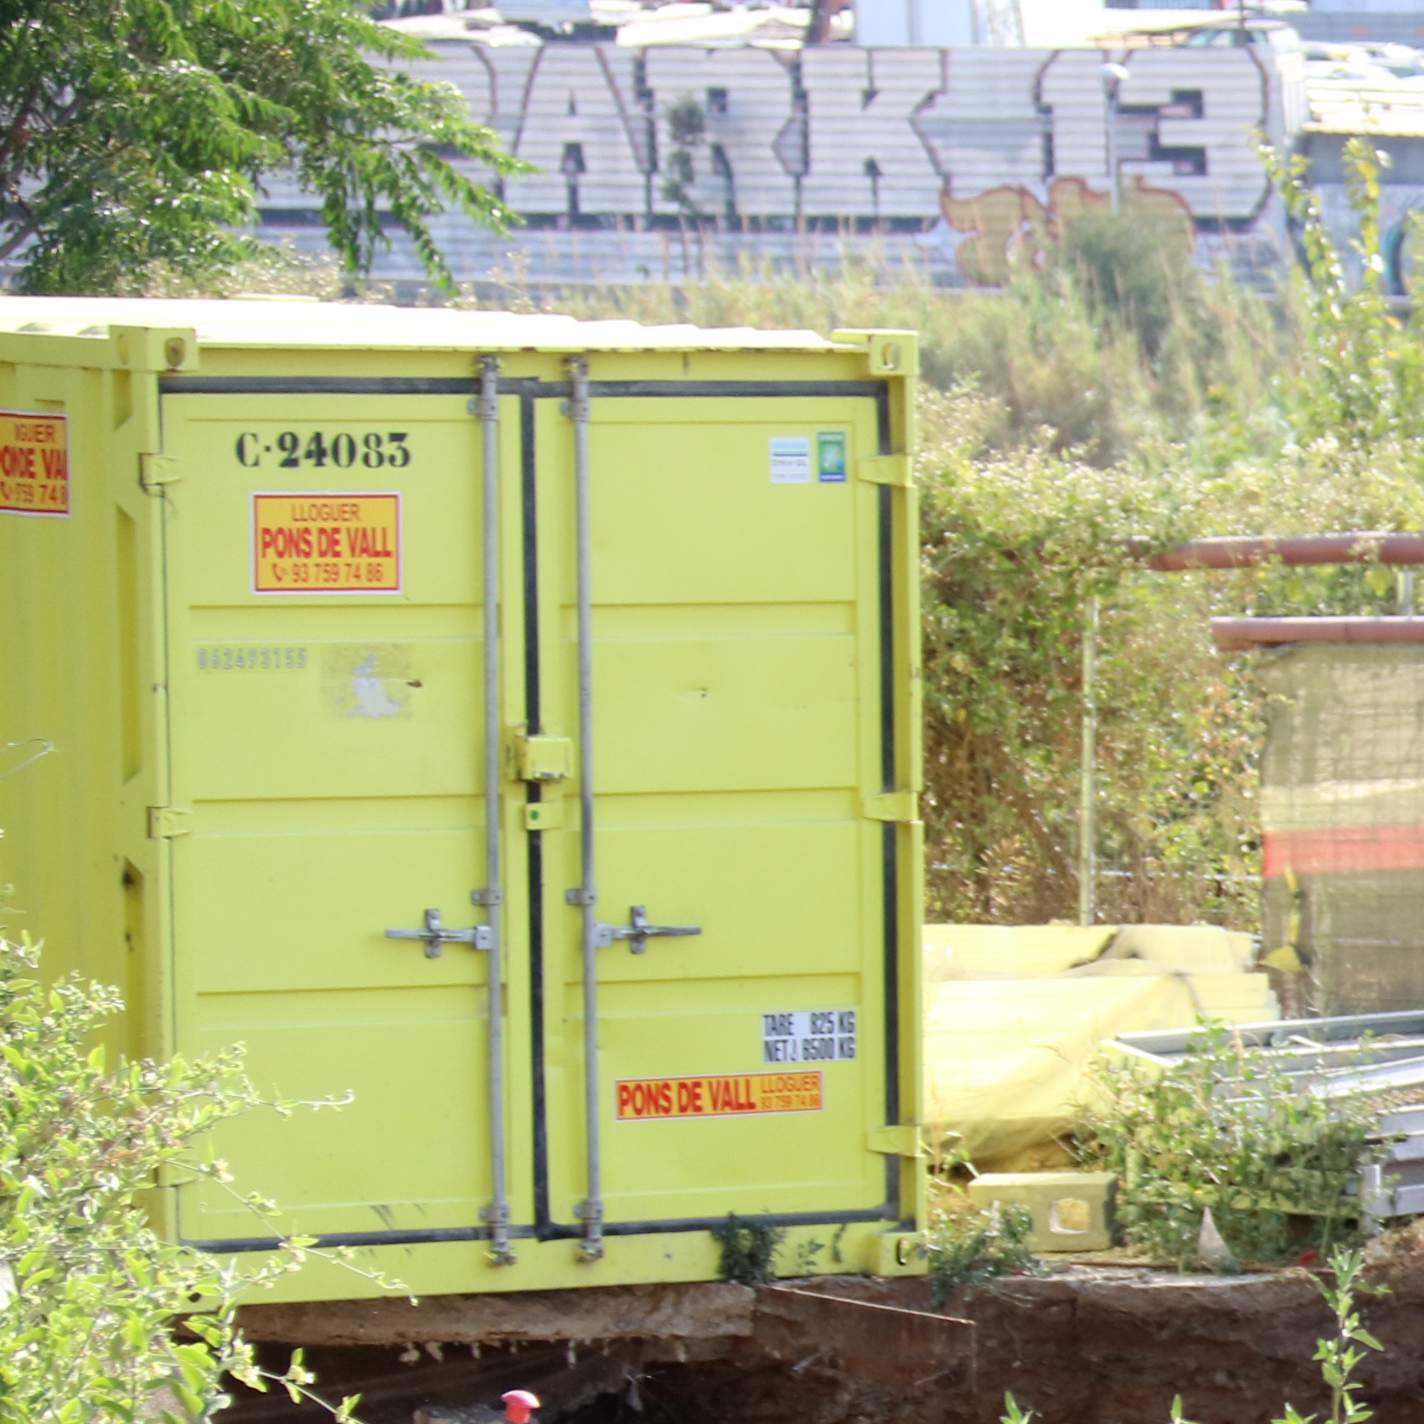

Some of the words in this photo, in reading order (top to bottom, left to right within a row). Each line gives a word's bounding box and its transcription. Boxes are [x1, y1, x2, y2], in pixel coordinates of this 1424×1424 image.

[291, 503, 360, 523] LLOGUER
[261, 527, 313, 559] PONS
[318, 527, 342, 558] DE
[346, 527, 392, 558] VALL
[292, 563, 310, 583] 93
[314, 563, 340, 583] 759
[344, 563, 361, 583] 74
[763, 1013, 795, 1036] TARE
[838, 1011, 855, 1034] KG
[838, 1036, 855, 1060] KG
[760, 1074, 819, 1094] LLOGUER
[617, 1082, 673, 1117] PONS
[677, 1080, 703, 1114] DE
[708, 1077, 757, 1112] VALL
